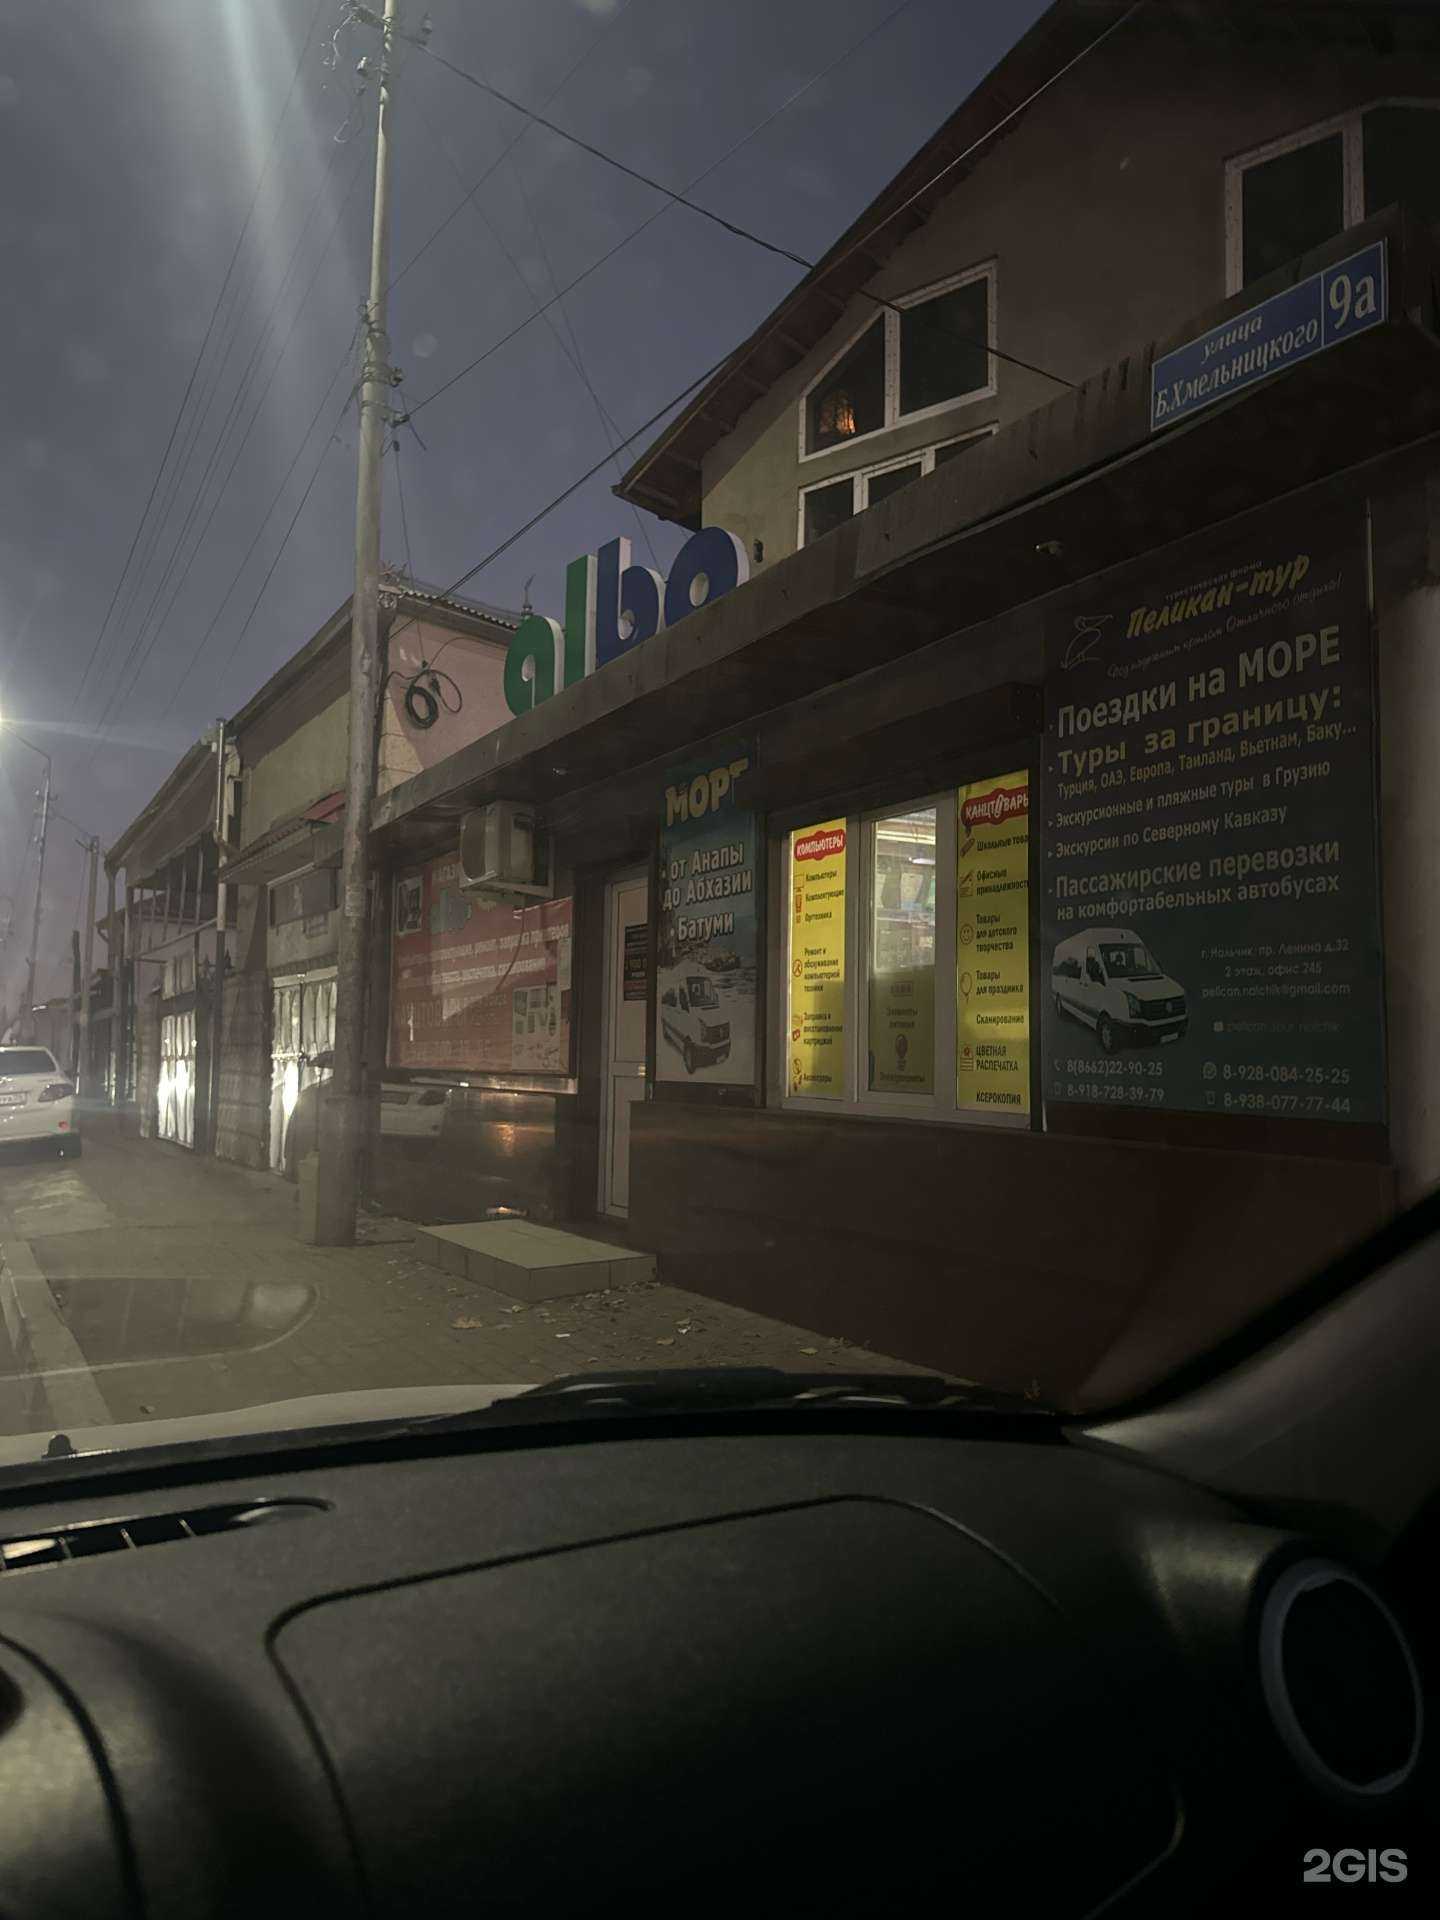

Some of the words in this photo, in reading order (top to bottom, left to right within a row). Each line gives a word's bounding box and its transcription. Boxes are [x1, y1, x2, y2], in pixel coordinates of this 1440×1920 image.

[1329, 273, 1377, 329] 9а
[1201, 314, 1263, 364] улица
[1155, 318, 1318, 418] Б.Хмельницкого
[504, 526, 750, 718] albo
[1126, 554, 1310, 639] Пеликан-тур
[1058, 681, 1176, 738] Поездки
[1188, 666, 1225, 703] на
[1238, 625, 1341, 688] МОРЕ
[1058, 742, 1126, 777] Туры
[1145, 727, 1176, 754] за
[1187, 685, 1342, 746] границу:
[1057, 779, 1097, 799] Турция,
[1101, 769, 1126, 790] ОАЭ,
[1130, 759, 1175, 784] Европа,
[1179, 747, 1235, 773] Таиланд,
[1240, 731, 1301, 758] Вьетнам,
[1056, 799, 1143, 829] Экскурсионные
[1146, 794, 1153, 810] и
[1157, 785, 1216, 810] пляжные
[1221, 777, 1254, 799] туры
[1263, 774, 1270, 789] в
[1275, 760, 1330, 786] Грузию
[797, 835, 843, 857] КОМПЬЮТЕРЫ
[1056, 834, 1119, 859] Экскурсии
[1123, 831, 1139, 847] по
[1142, 816, 1220, 845] Северному
[1224, 804, 1288, 830] Кавказу
[671, 858, 688, 880] от
[691, 843, 744, 874] Анапы
[1056, 859, 1201, 898] Пассажирские
[1208, 841, 1340, 880] перевозки
[663, 888, 681, 912] до
[686, 869, 752, 905] Абхазии
[1057, 903, 1074, 921] на
[1078, 887, 1232, 919] комфортабельных
[1238, 872, 1340, 902] автобусах
[677, 912, 734, 942] Батуми
[1223, 1064, 1350, 1085] 8-928-084-25-25
[1223, 1093, 1351, 1113] 8-938-077-77-44
